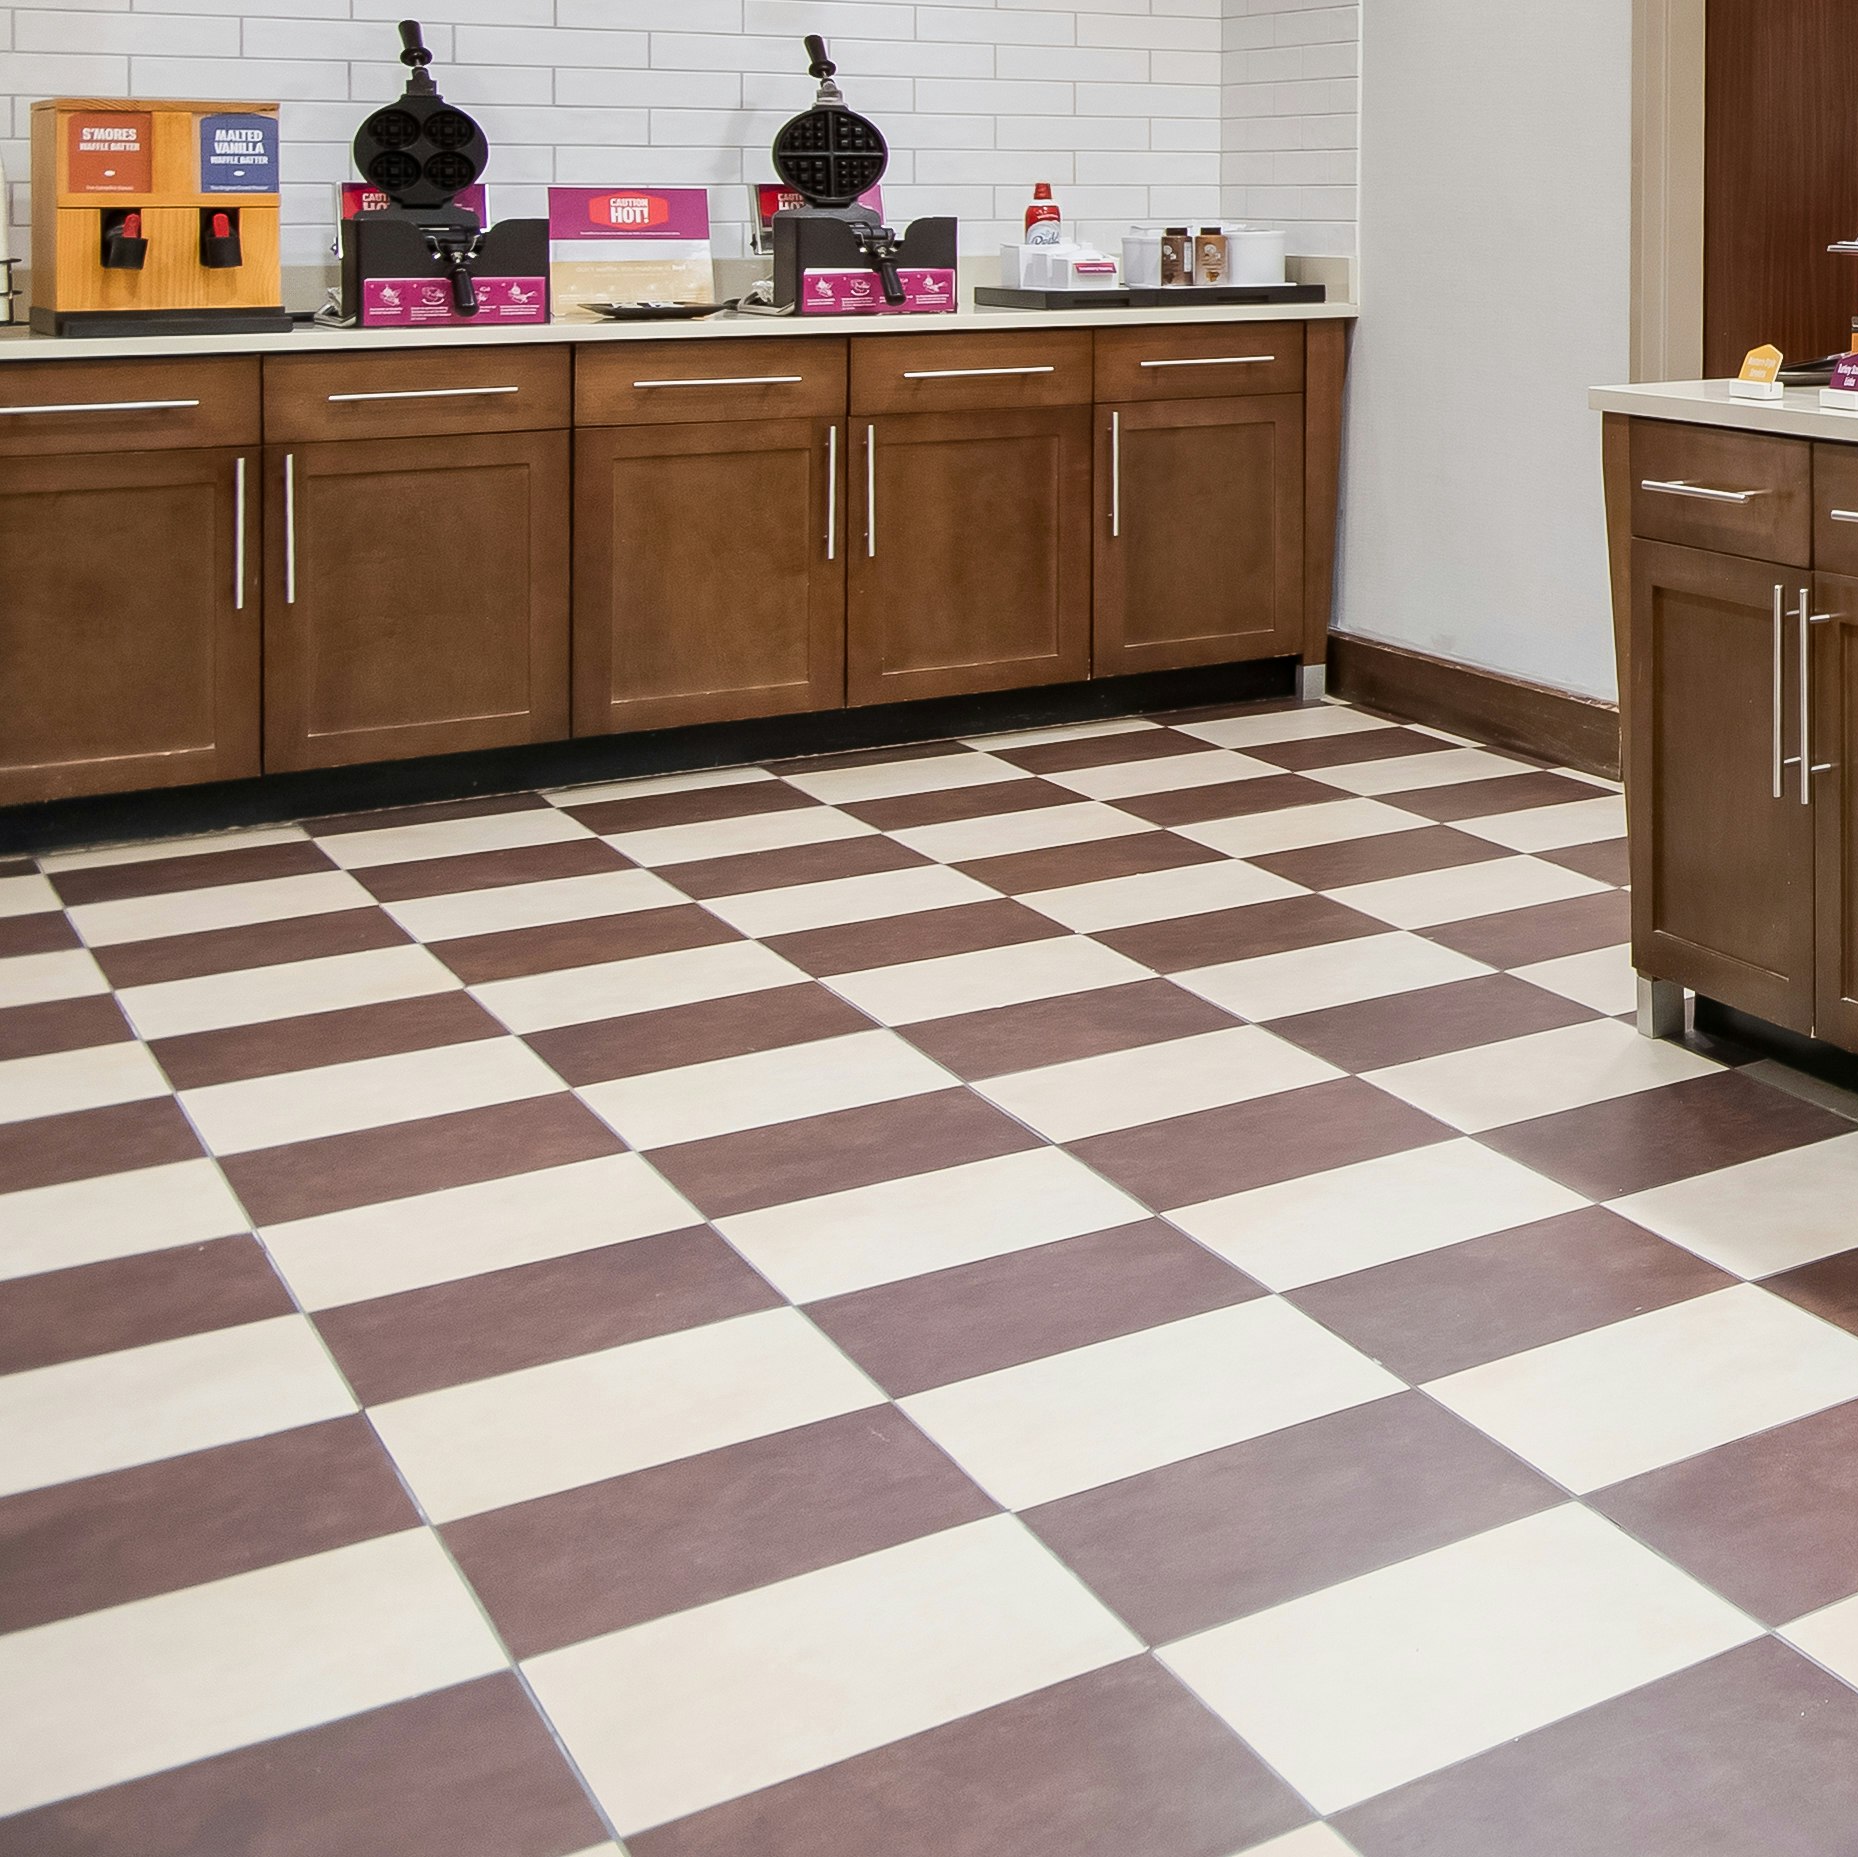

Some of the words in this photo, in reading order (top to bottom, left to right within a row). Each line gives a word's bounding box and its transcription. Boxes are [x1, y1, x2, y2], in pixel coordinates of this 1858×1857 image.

[82, 128, 137, 140] S'MORES
[215, 129, 263, 141] MALTED
[214, 142, 265, 154] VANILLA
[610, 198, 649, 207] CAUTION
[610, 207, 649, 223] HOT!
